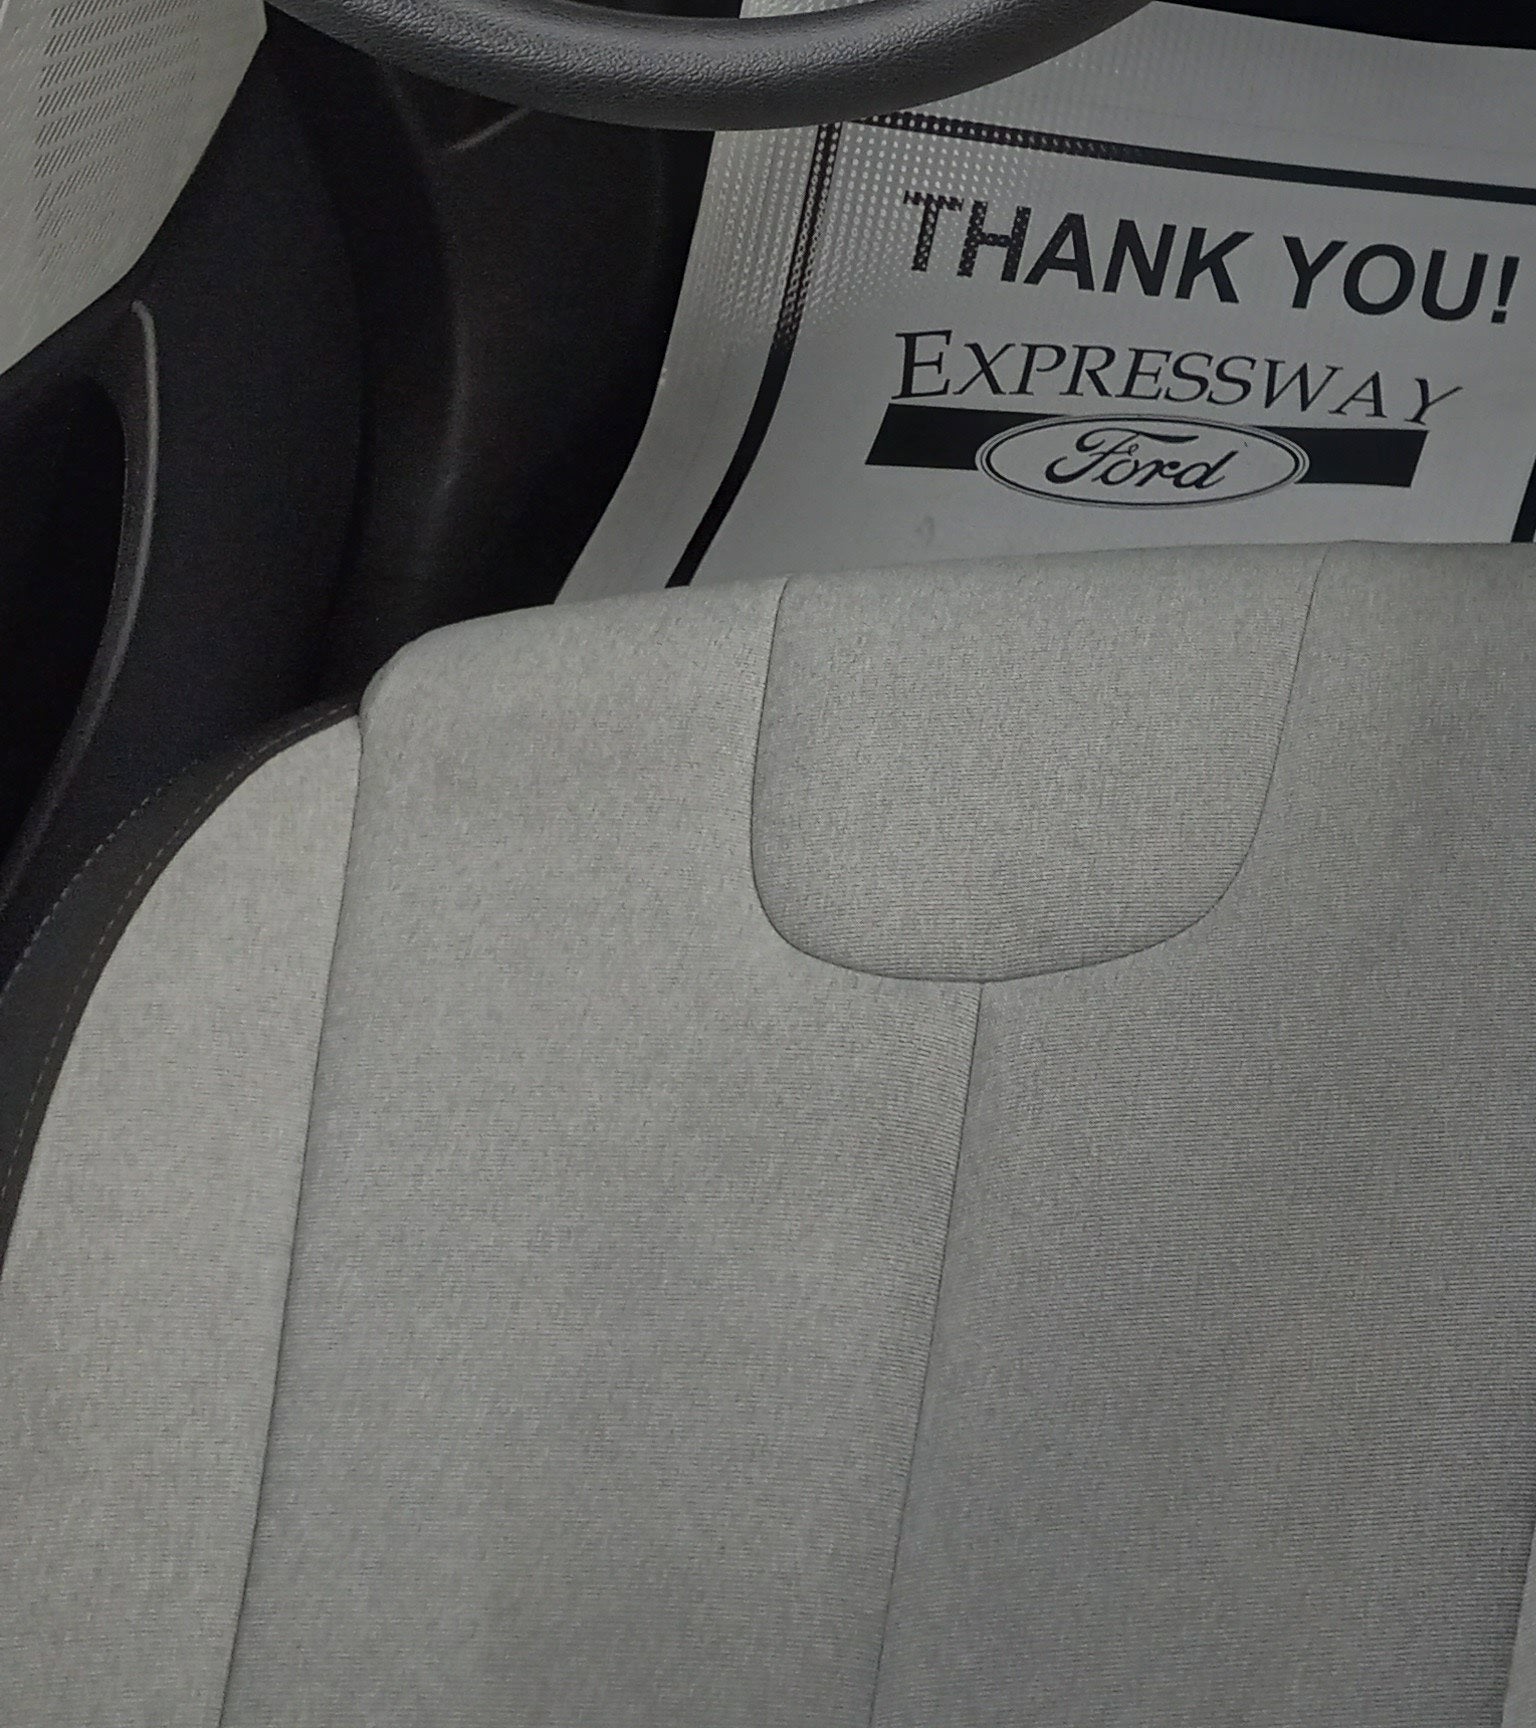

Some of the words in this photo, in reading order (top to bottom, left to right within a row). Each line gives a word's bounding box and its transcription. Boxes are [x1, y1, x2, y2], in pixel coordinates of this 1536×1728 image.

[902, 190, 1254, 304] THANK
[1280, 235, 1521, 325] YOU!
[890, 328, 1463, 426] EXPRESSWAY
[1044, 426, 1240, 491] Ford
